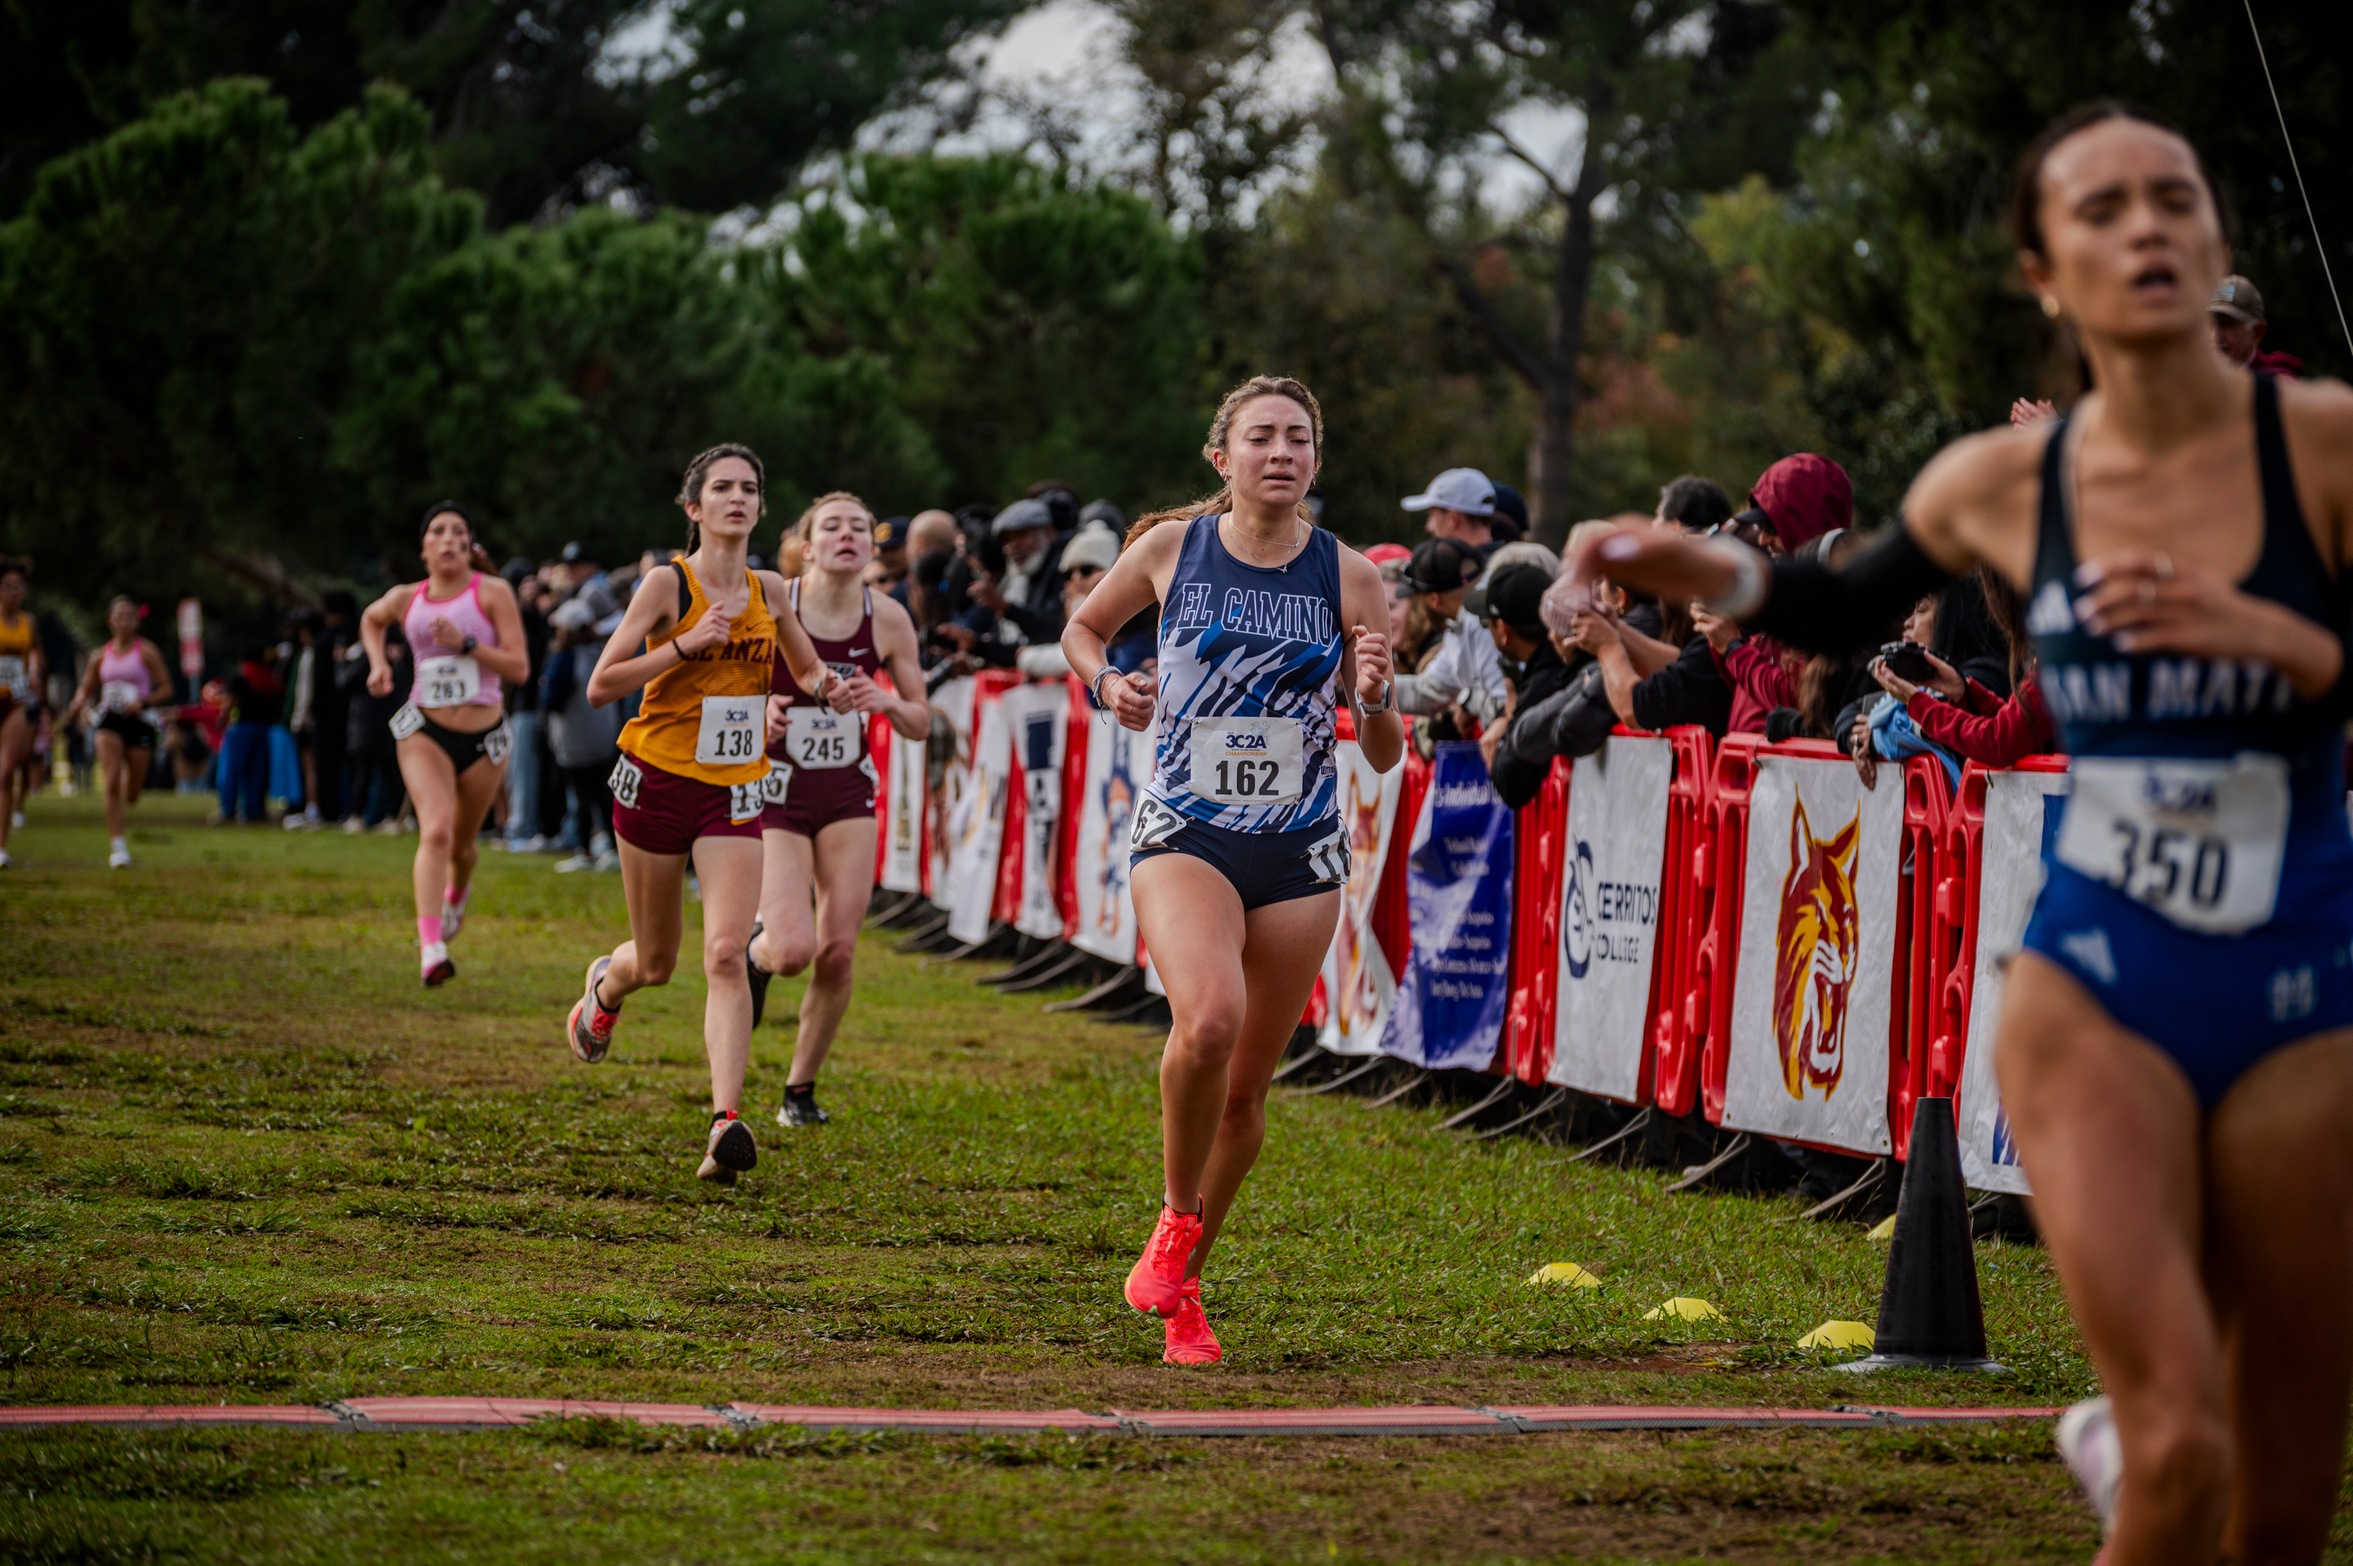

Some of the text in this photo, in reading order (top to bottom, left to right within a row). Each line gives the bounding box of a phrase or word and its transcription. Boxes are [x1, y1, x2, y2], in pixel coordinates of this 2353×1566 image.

[1176, 583, 1334, 647] EL CAMINO
[719, 637, 773, 665] ANZA
[715, 729, 753, 756] 138
[802, 736, 845, 761] 245
[1225, 734, 1267, 749] 3C2A
[1215, 760, 1280, 796] 162
[2112, 818, 2230, 911] 350
